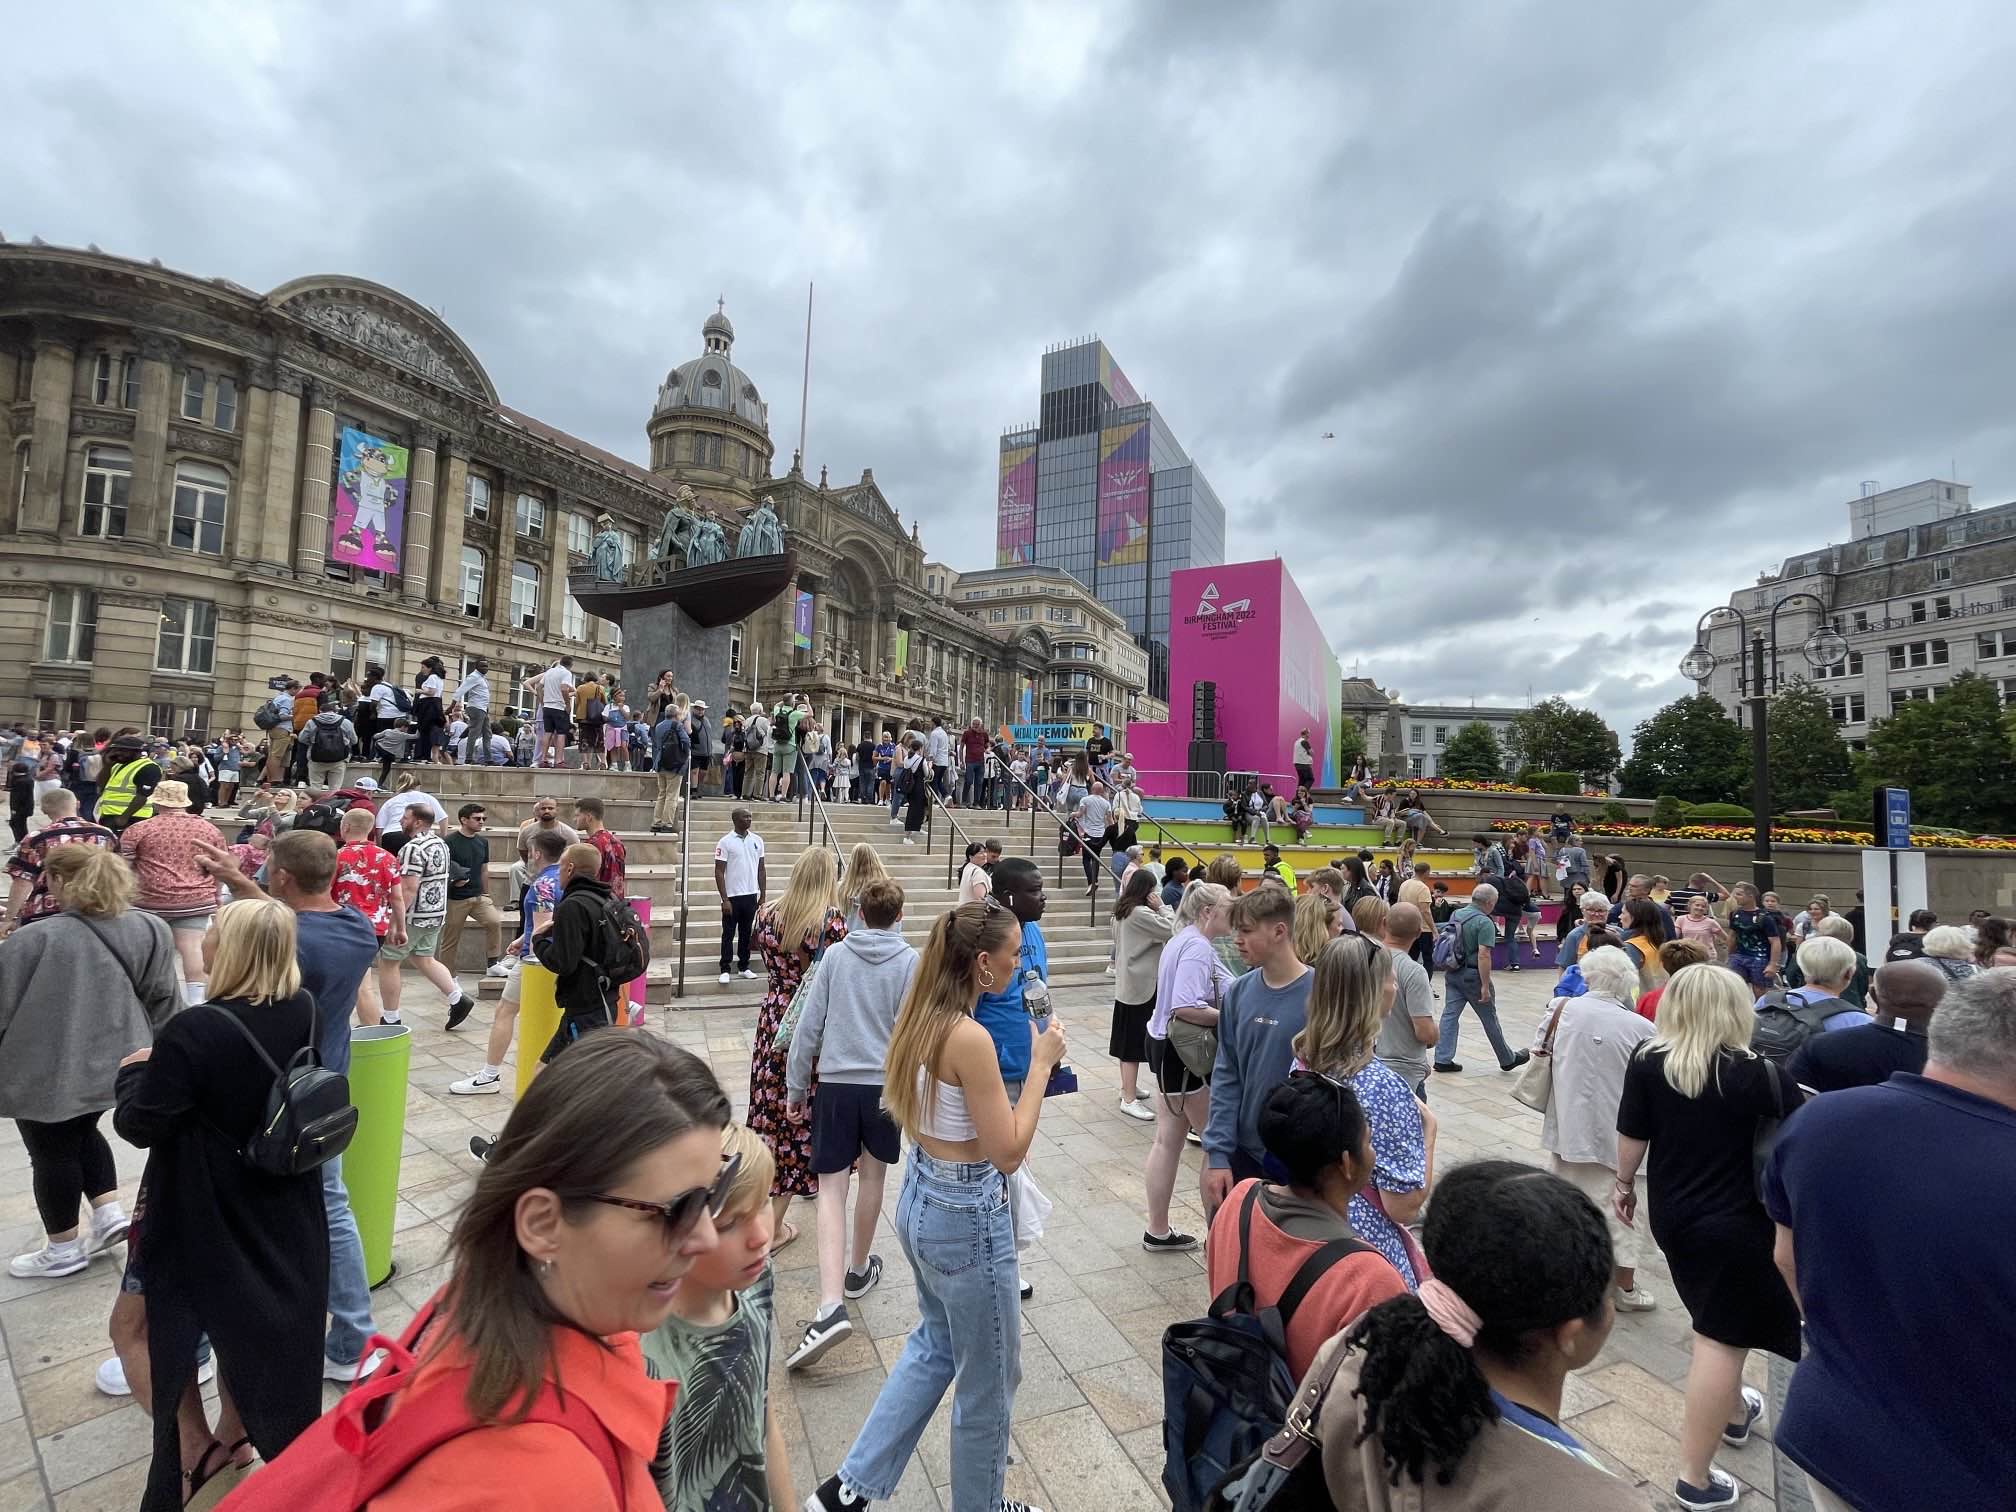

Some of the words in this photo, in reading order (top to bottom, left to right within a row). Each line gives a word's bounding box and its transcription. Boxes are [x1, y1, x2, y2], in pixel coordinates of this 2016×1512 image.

[1184, 612, 1234, 624] BIRMINGHAM
[1236, 610, 1256, 620] 2022
[1202, 621, 1237, 631] FESTIVAL
